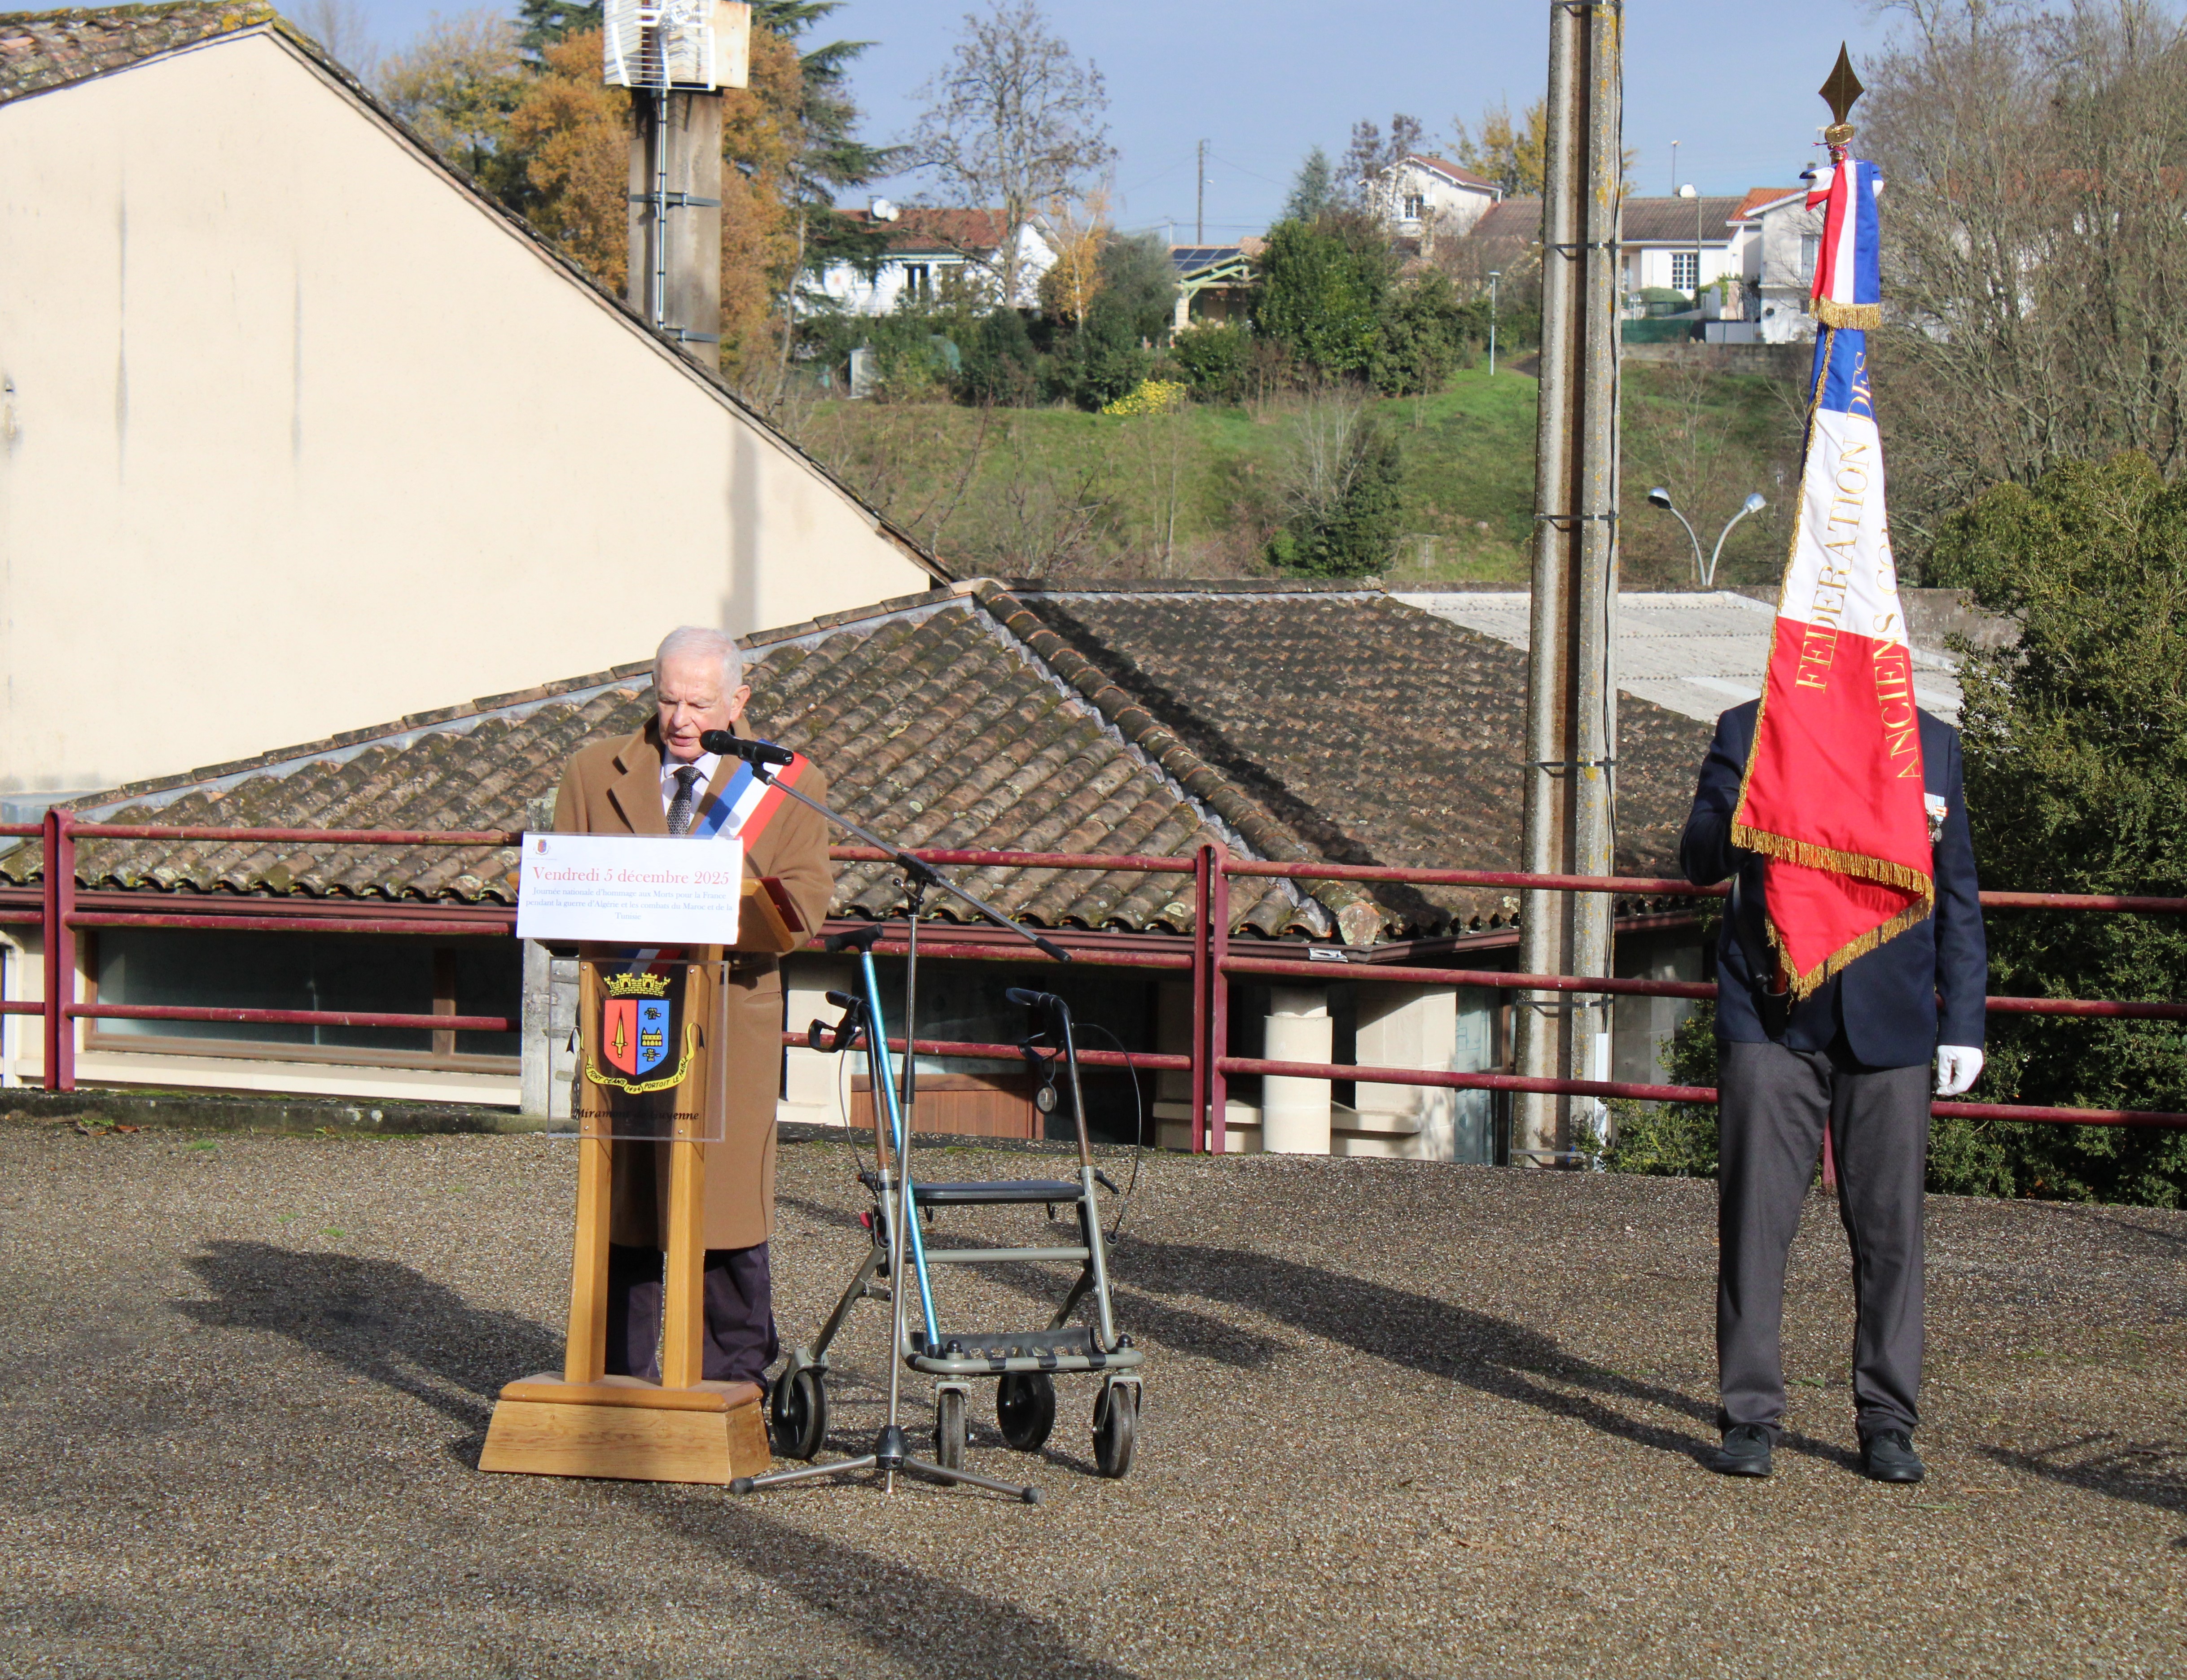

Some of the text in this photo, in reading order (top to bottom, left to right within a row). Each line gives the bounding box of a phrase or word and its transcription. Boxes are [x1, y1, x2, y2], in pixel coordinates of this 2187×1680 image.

[1795, 351, 1873, 694] FEDERATION DES
[1872, 612, 1922, 781] ANCIENS
[532, 866, 729, 884] Vendredi 5 décembre 2025
[532, 887, 561, 895] Journée
[562, 888, 594, 896] nationale
[596, 888, 636, 897] d'hommage
[526, 899, 554, 907] pendant
[587, 900, 619, 909] d'Algérie
[614, 912, 641, 920] Tunisie
[587, 1070, 605, 1081] FORT
[644, 1056, 689, 1089] PORTOIT LE FAIBLE
